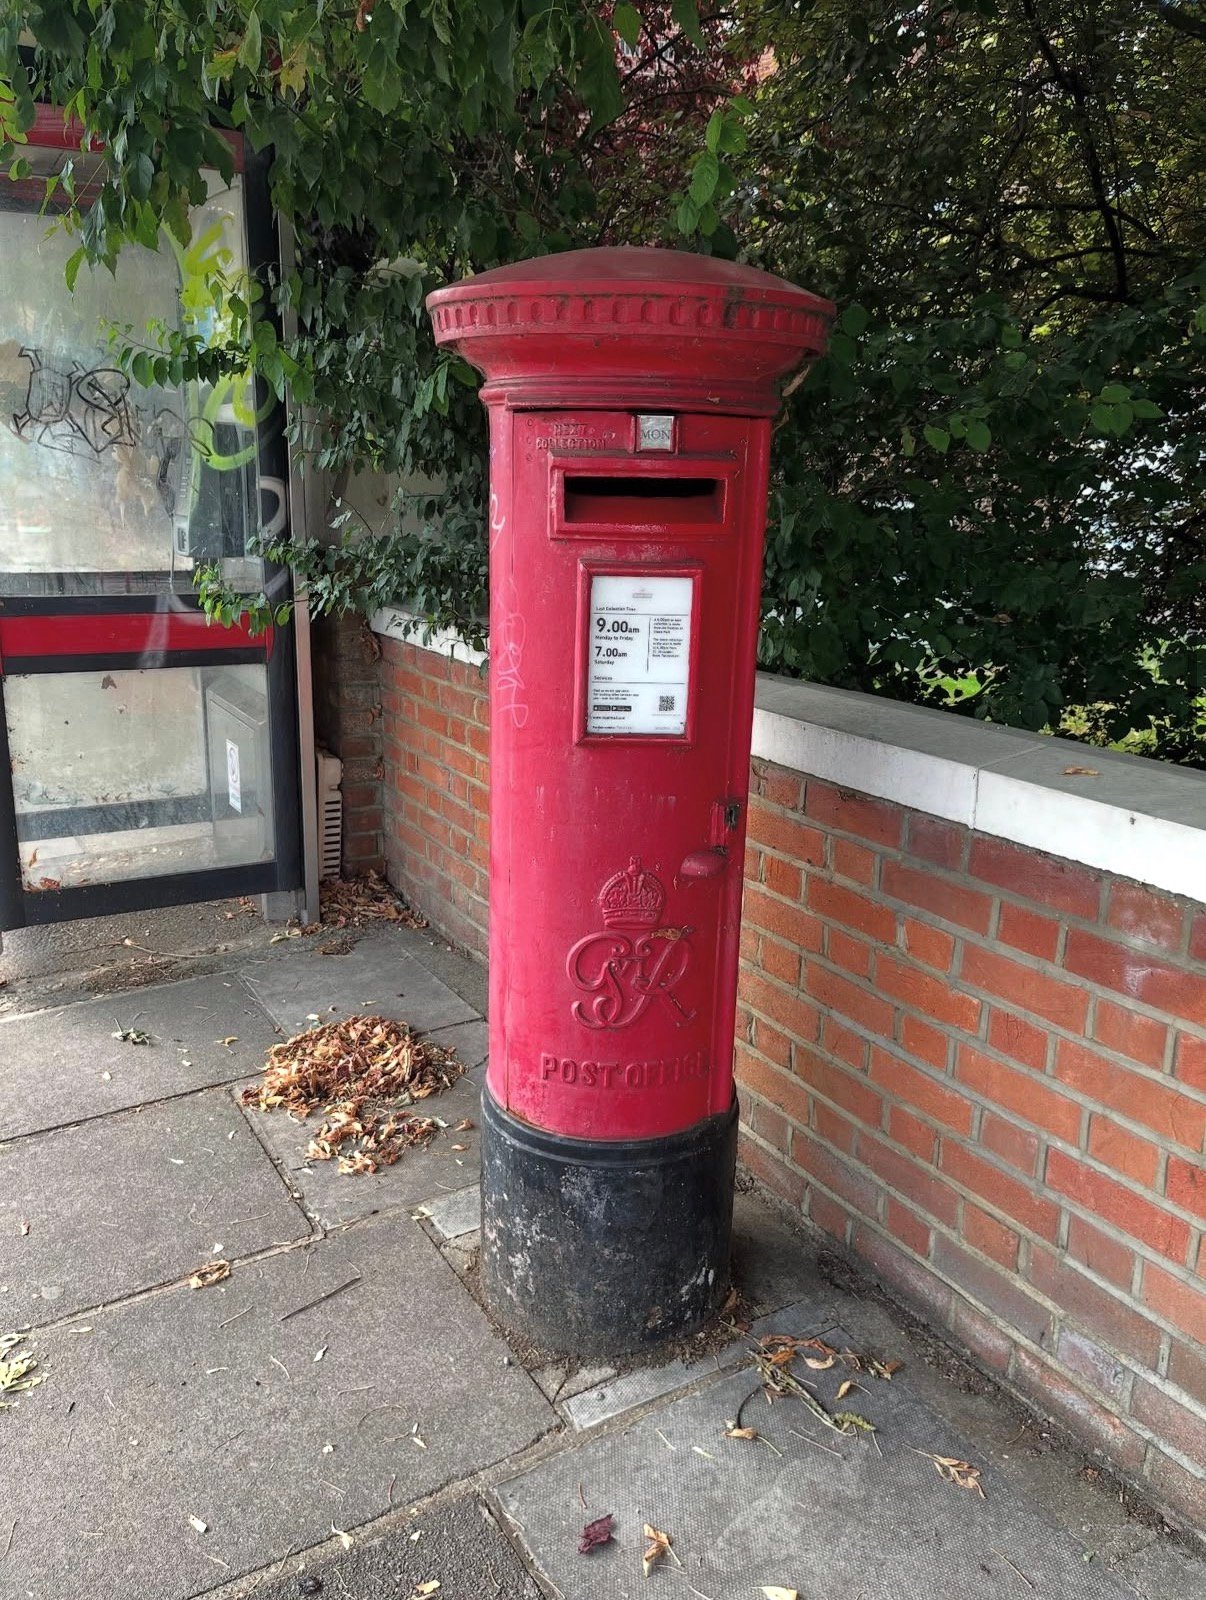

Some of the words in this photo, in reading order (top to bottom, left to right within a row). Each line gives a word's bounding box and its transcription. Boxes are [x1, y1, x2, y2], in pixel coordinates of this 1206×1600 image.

[642, 429, 670, 440] MON
[536, 436, 606, 450] COLLECTION
[597, 618, 639, 633] 9.00am
[595, 646, 627, 657] 7.00am
[541, 1052, 617, 1088] POST
